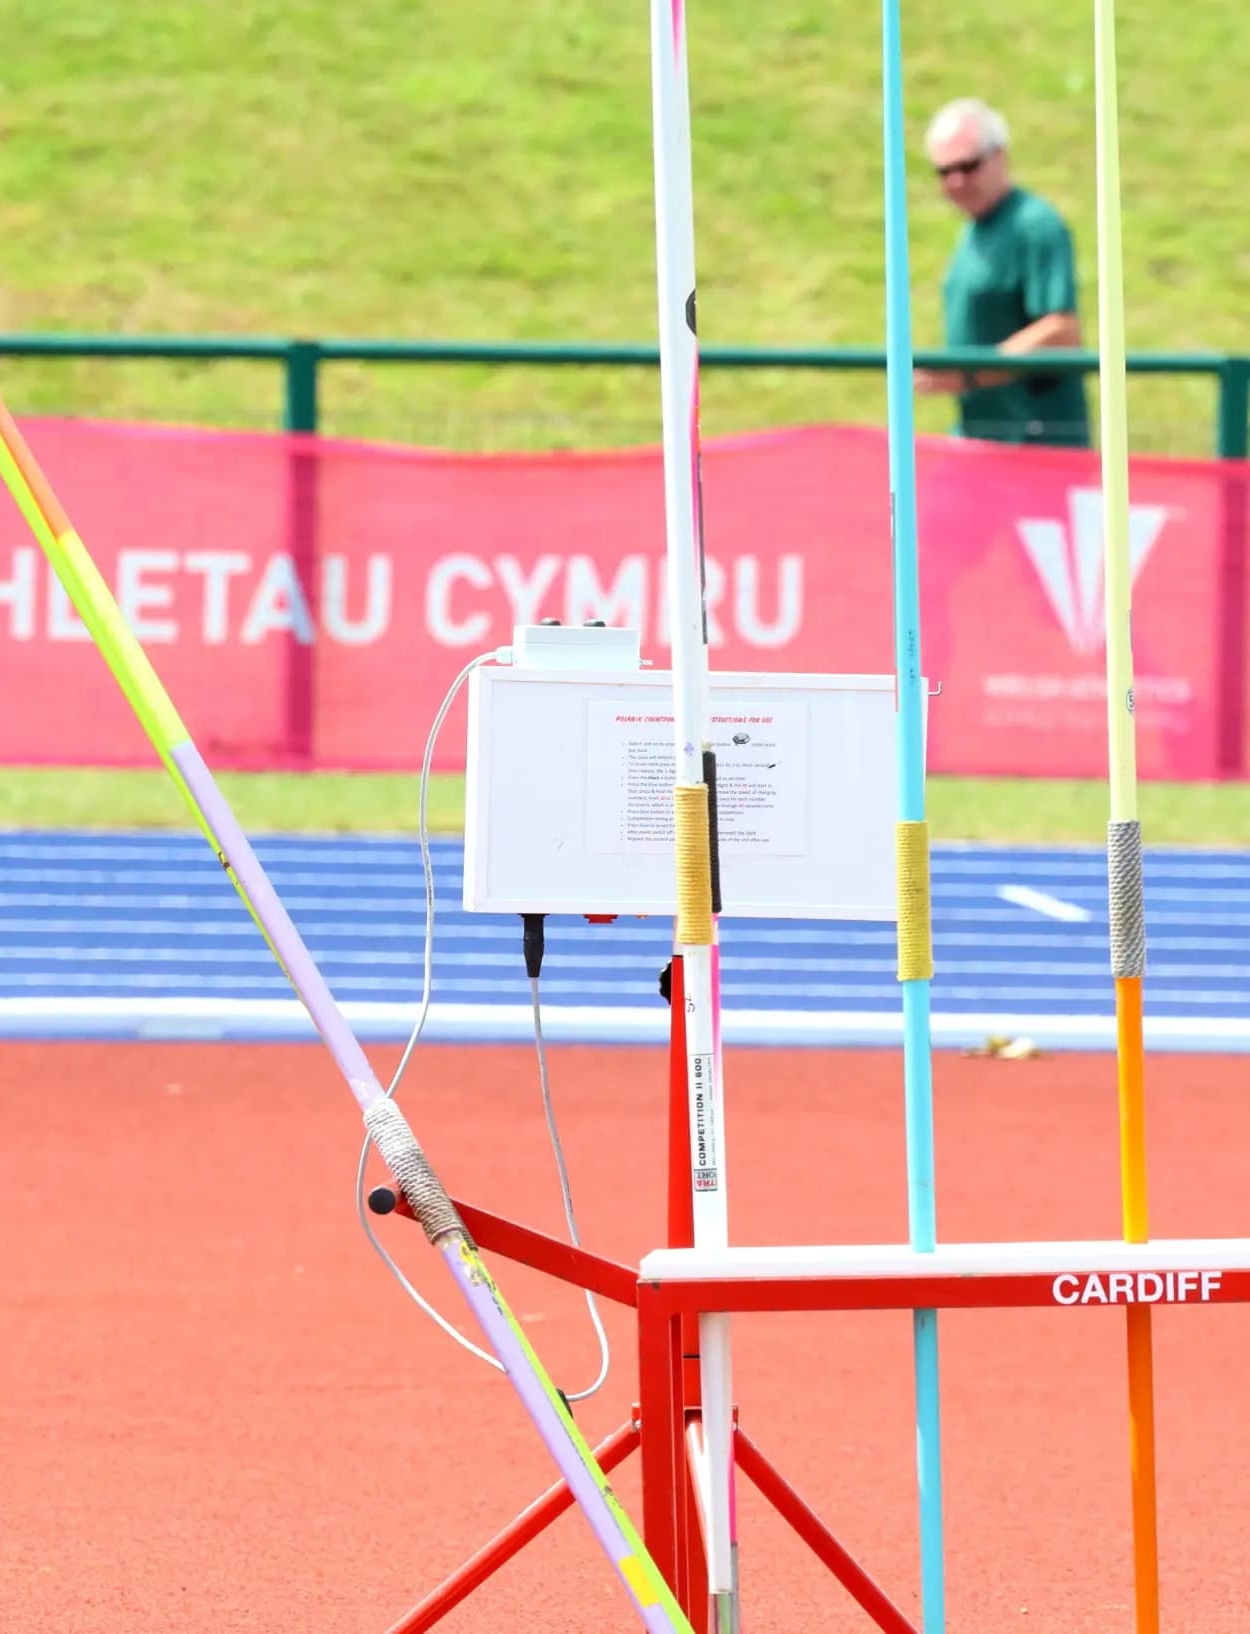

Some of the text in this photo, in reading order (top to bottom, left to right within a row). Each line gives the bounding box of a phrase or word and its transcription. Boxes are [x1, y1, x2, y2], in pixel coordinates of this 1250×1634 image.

[694, 1057, 703, 1078] 600
[696, 1093, 707, 1167] COMPETITION
[1051, 1271, 1223, 1305] CARDIFF
